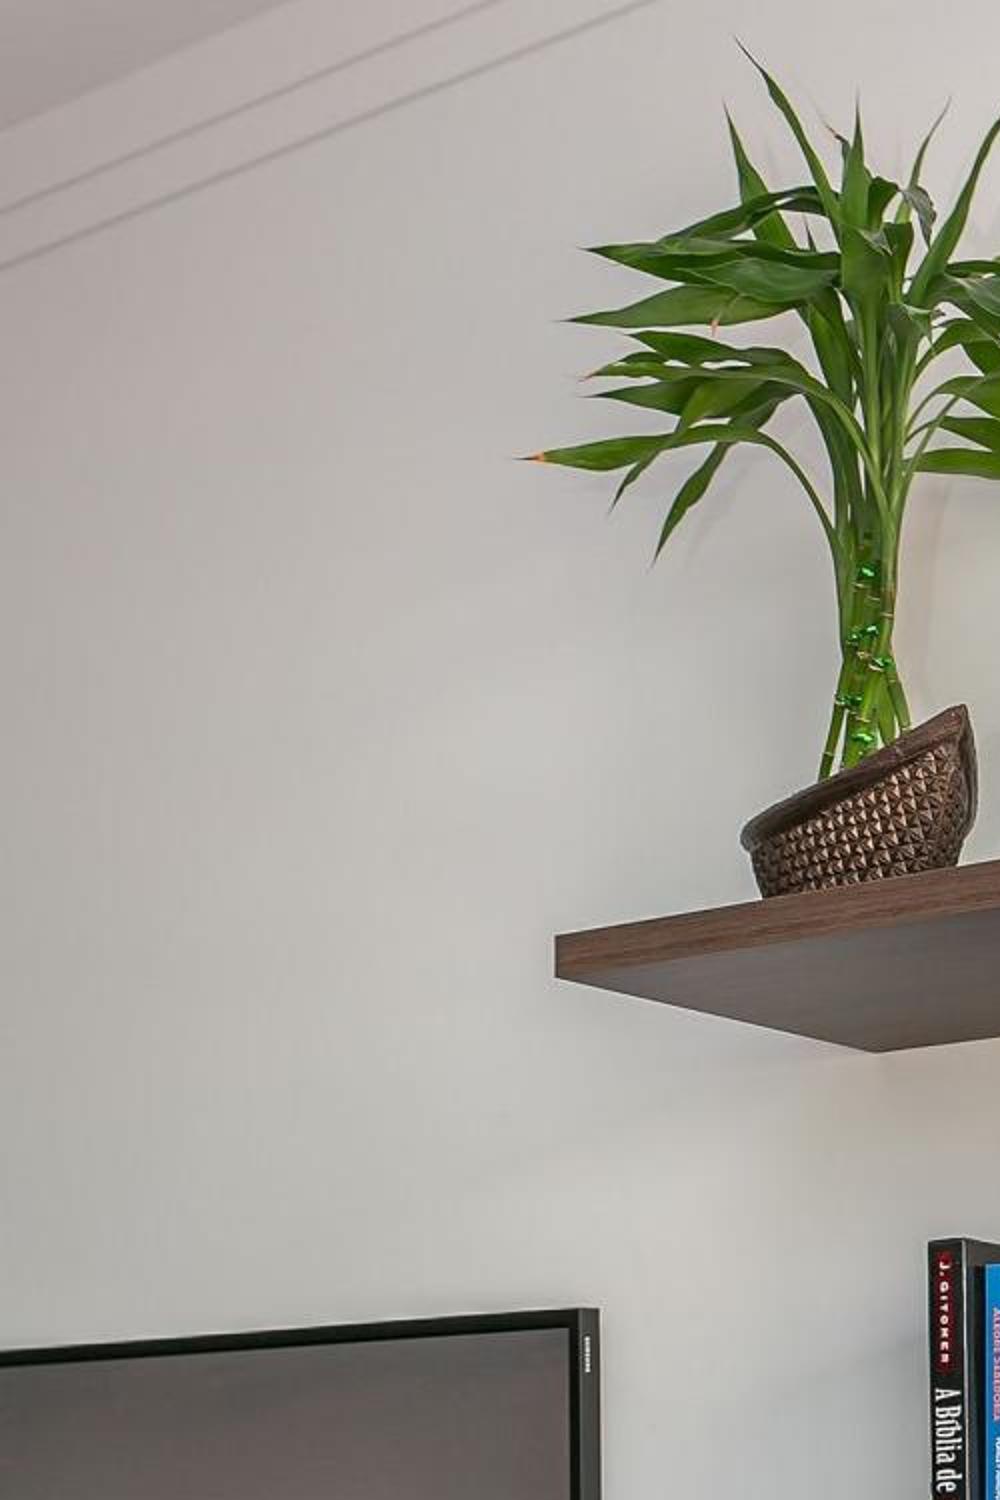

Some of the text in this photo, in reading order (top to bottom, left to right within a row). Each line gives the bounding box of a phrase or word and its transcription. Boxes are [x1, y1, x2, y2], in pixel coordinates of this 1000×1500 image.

[939, 1261, 951, 1364] J. GITOMER
[935, 1388, 963, 1494] A Bíblia de
